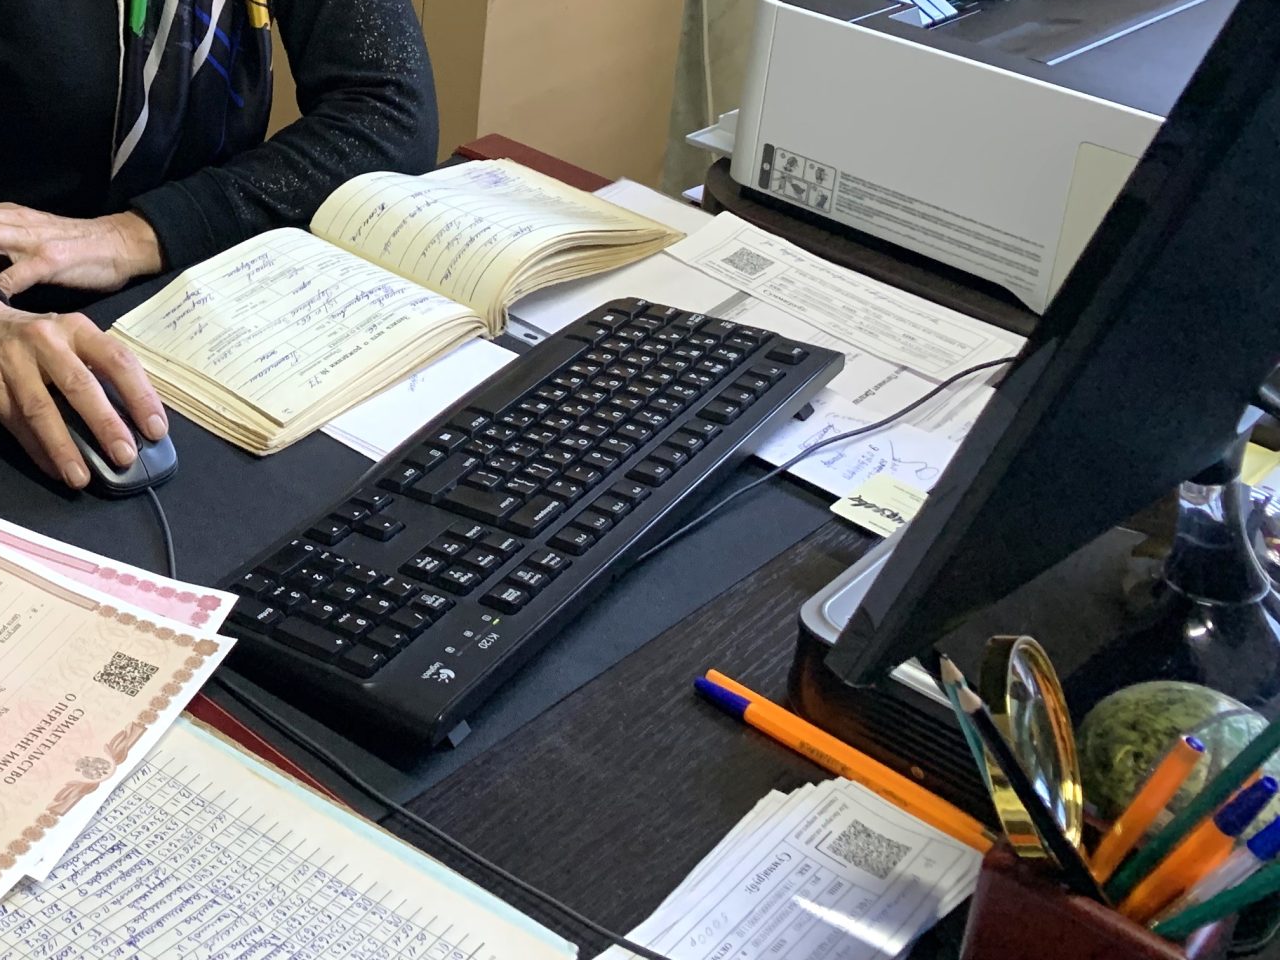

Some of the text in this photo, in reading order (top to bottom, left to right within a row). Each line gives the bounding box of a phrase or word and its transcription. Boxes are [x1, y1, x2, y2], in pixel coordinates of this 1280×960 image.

[328, 343, 361, 369] рождении
[499, 497, 514, 508] Enter
[534, 501, 559, 520] Backspace
[257, 607, 273, 619] Enter
[478, 632, 499, 649] K120
[421, 661, 443, 679] Logitech
[62, 691, 78, 702] О
[12, 701, 69, 751] ПЕРЕМЕНЕ
[0, 706, 85, 786] СВИДЕТЕЛЬСТВО
[742, 848, 793, 898] Сумма(руб):
